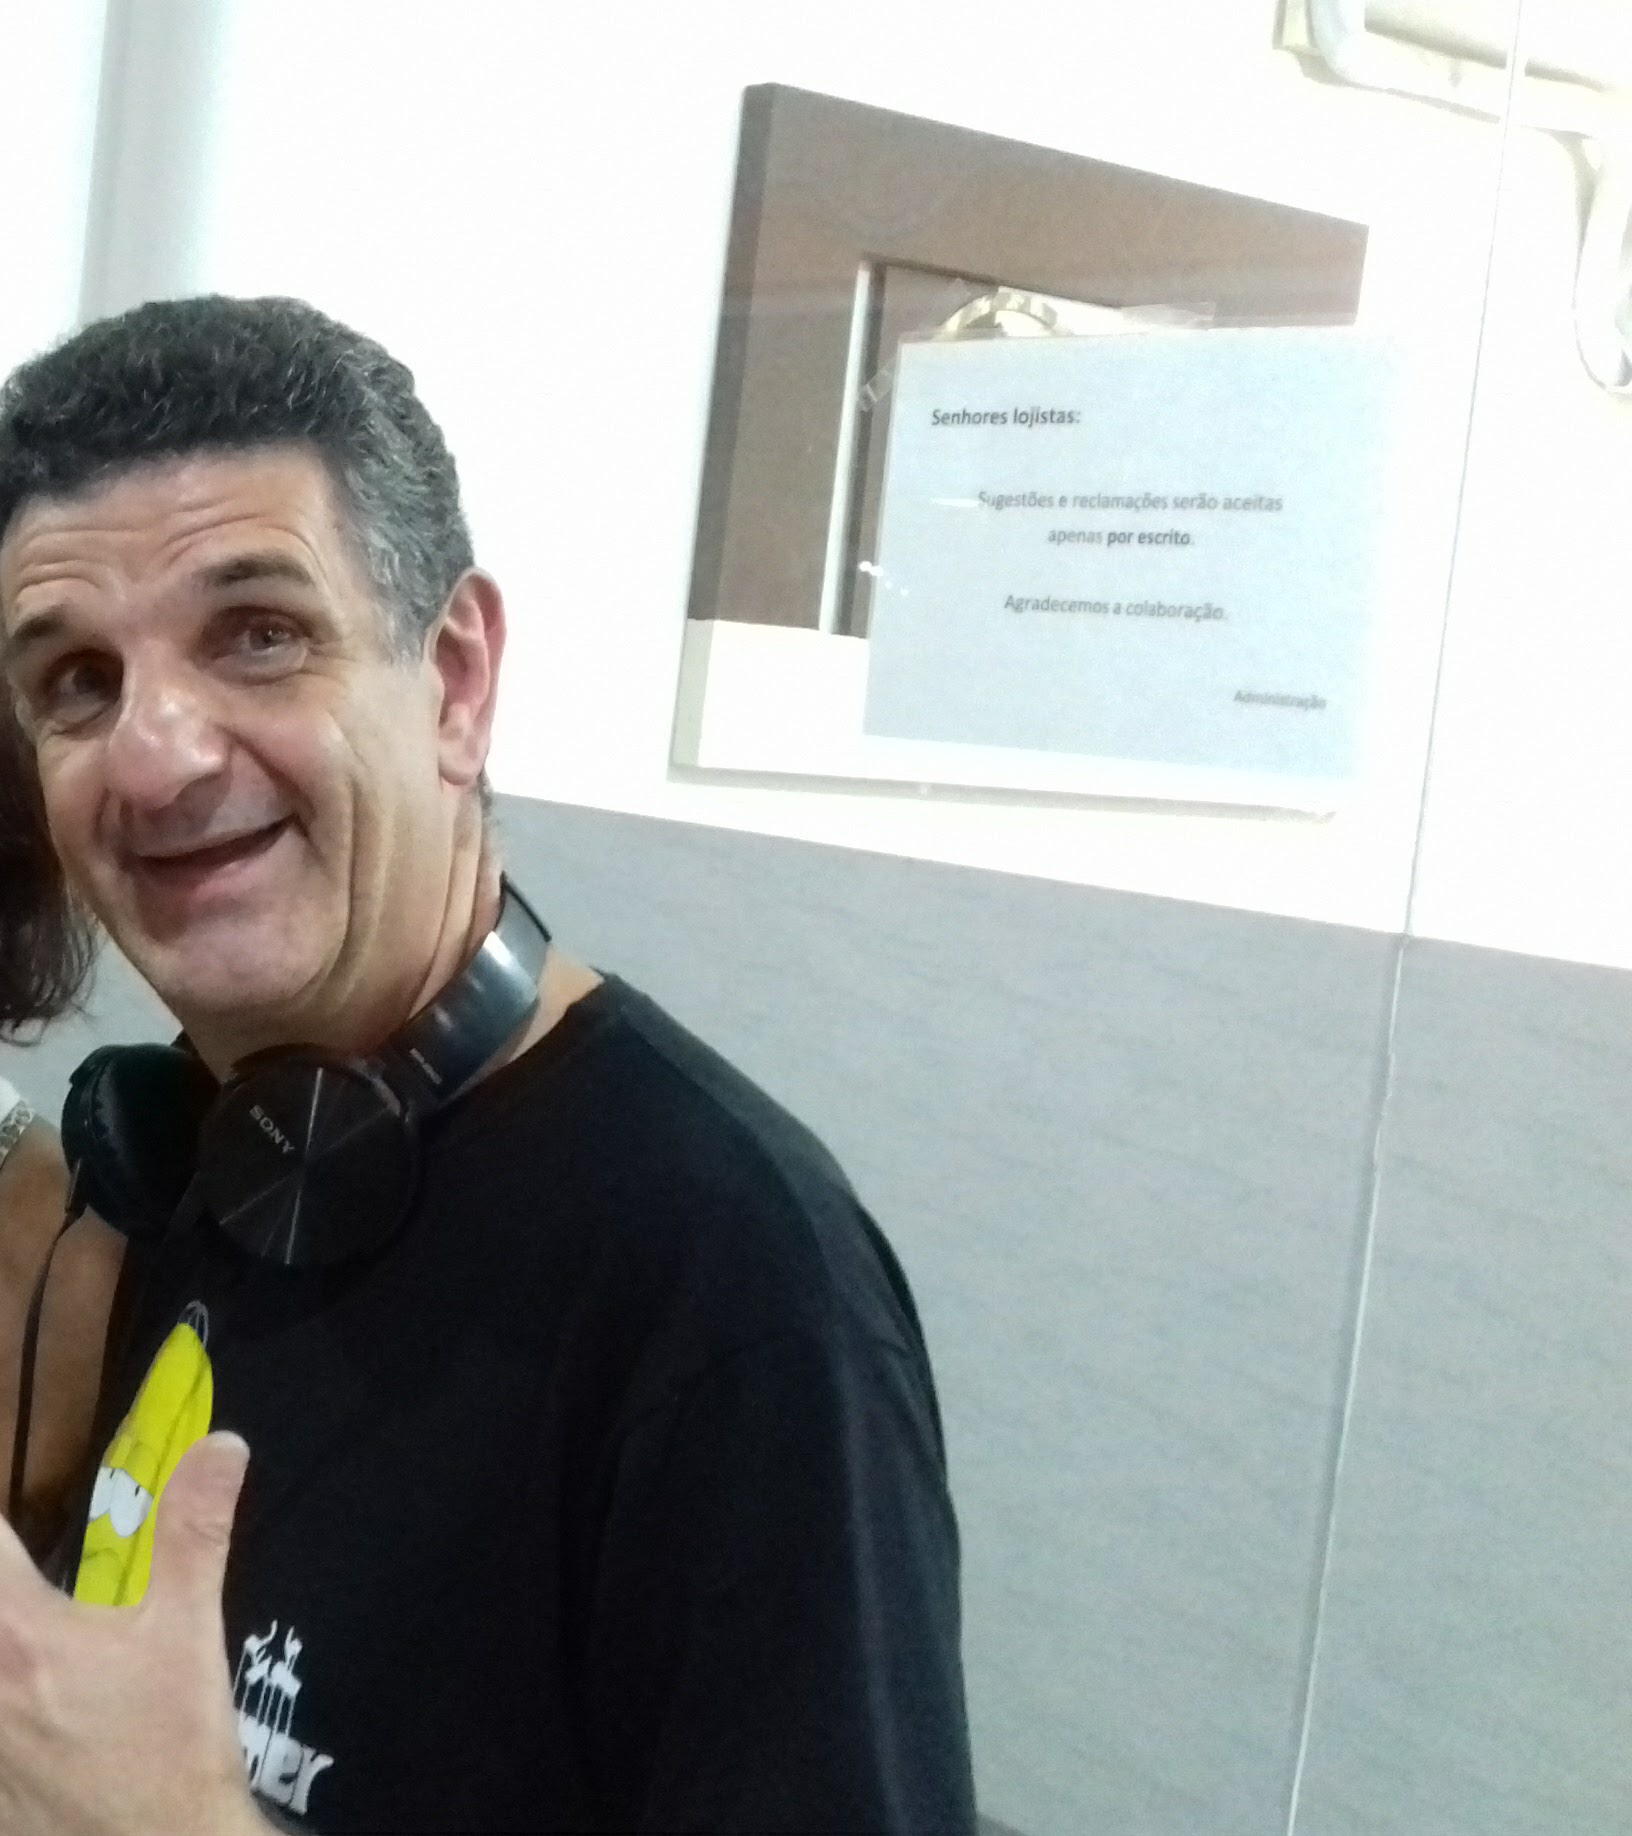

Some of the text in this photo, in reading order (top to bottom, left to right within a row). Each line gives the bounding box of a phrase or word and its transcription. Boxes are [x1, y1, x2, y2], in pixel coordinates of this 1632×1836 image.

[931, 406, 1081, 428] Senhores lojistas:
[979, 491, 1283, 512] Sugestões e reclamações serão aceitas
[1048, 528, 1195, 547] apenas por escrito.
[1004, 595, 1229, 622] Agradecemos a colaboração.
[249, 1104, 295, 1154] SONY
